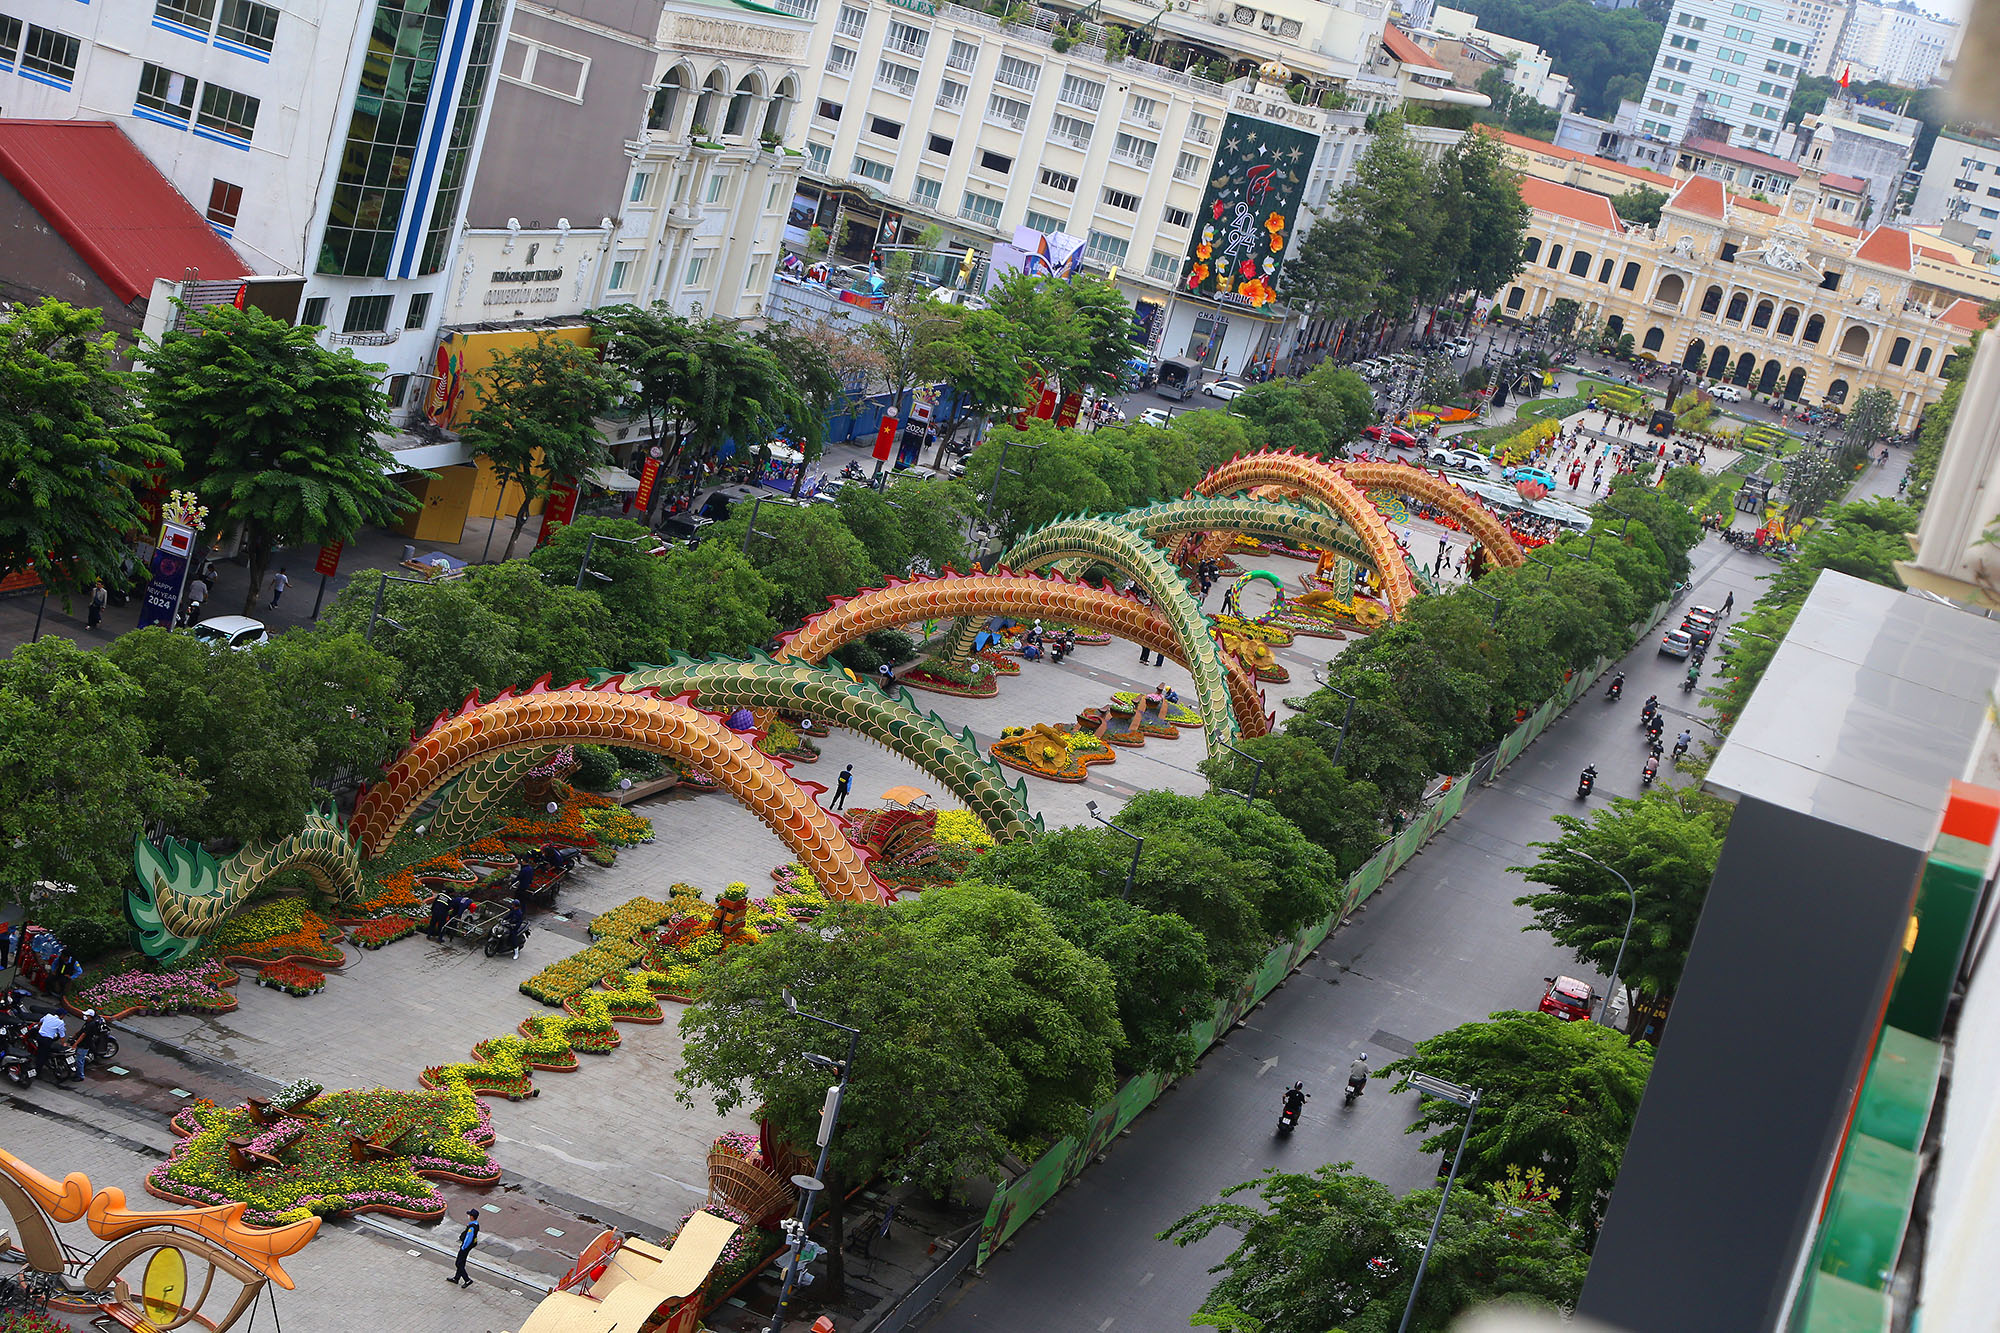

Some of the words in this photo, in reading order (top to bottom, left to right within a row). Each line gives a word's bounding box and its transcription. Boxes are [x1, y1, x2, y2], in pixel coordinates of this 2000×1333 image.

[1234, 95, 1262, 114] REX
[1264, 103, 1318, 129] HOTEL
[1061, 410, 1077, 419] 2024
[906, 422, 925, 435] 2024
[153, 580, 173, 592] HAPPY
[146, 586, 161, 597] NEW
[160, 590, 177, 601] YEAR
[147, 595, 171, 610] 2024
